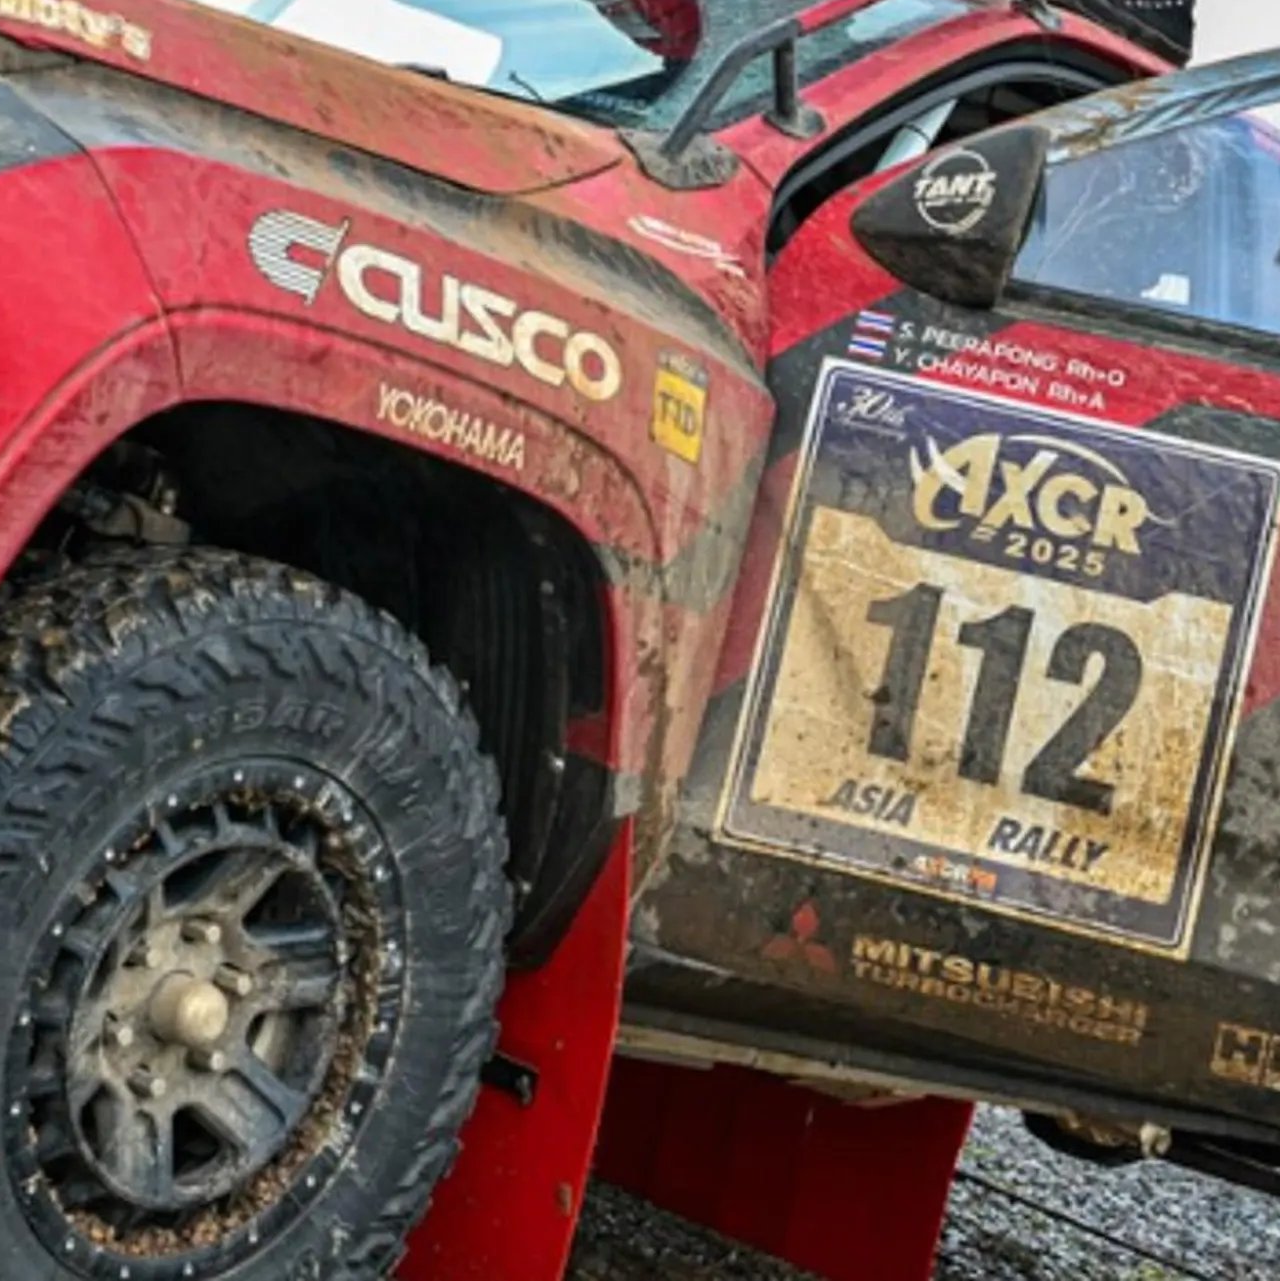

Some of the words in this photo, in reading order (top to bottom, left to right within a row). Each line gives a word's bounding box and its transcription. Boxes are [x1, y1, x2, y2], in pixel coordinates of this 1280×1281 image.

[337, 244, 622, 402] CUSCO
[922, 325, 1058, 373] PEERAPONG
[917, 351, 1039, 397] CHAYAPON
[376, 382, 526, 469] YOKOHAMA
[910, 432, 1152, 556] AXCR
[1004, 532, 1107, 577] 2025
[866, 581, 1144, 817] 112
[824, 778, 917, 827] ASIA
[987, 816, 1112, 873] RALLY
[851, 933, 1150, 1032] MITSUBISHI
